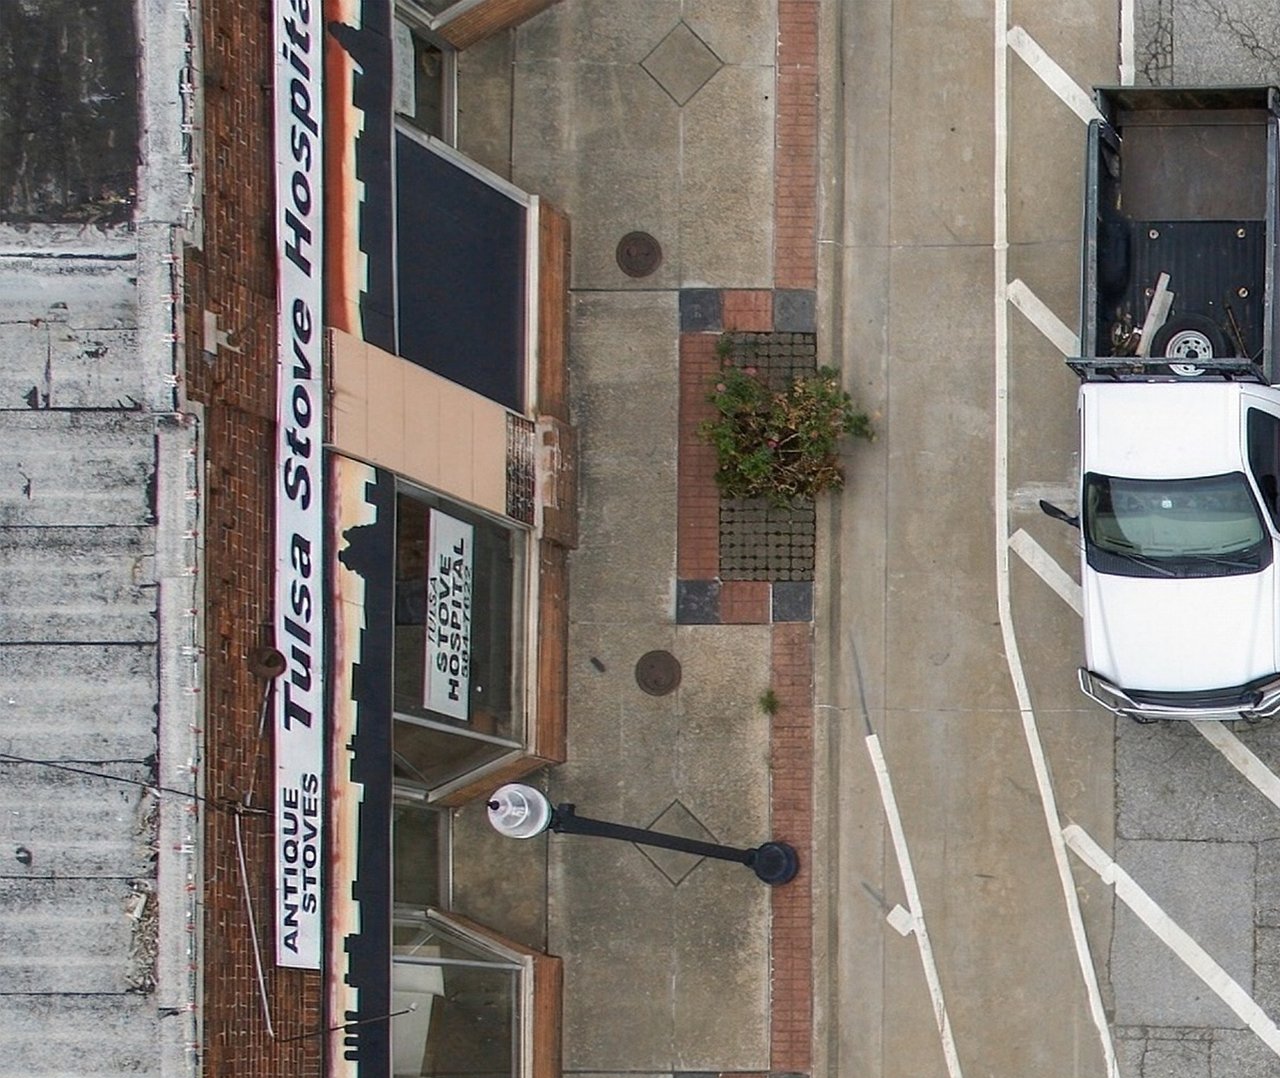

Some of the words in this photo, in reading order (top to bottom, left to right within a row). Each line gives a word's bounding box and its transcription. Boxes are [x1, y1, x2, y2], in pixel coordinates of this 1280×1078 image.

[284, 299, 312, 511] Stove
[282, 533, 312, 731] Tulsa
[436, 554, 451, 674] STOVE
[448, 538, 464, 701] HOSPITAL
[284, 787, 299, 953] ANTIQUE
[302, 773, 318, 914] STOVES
